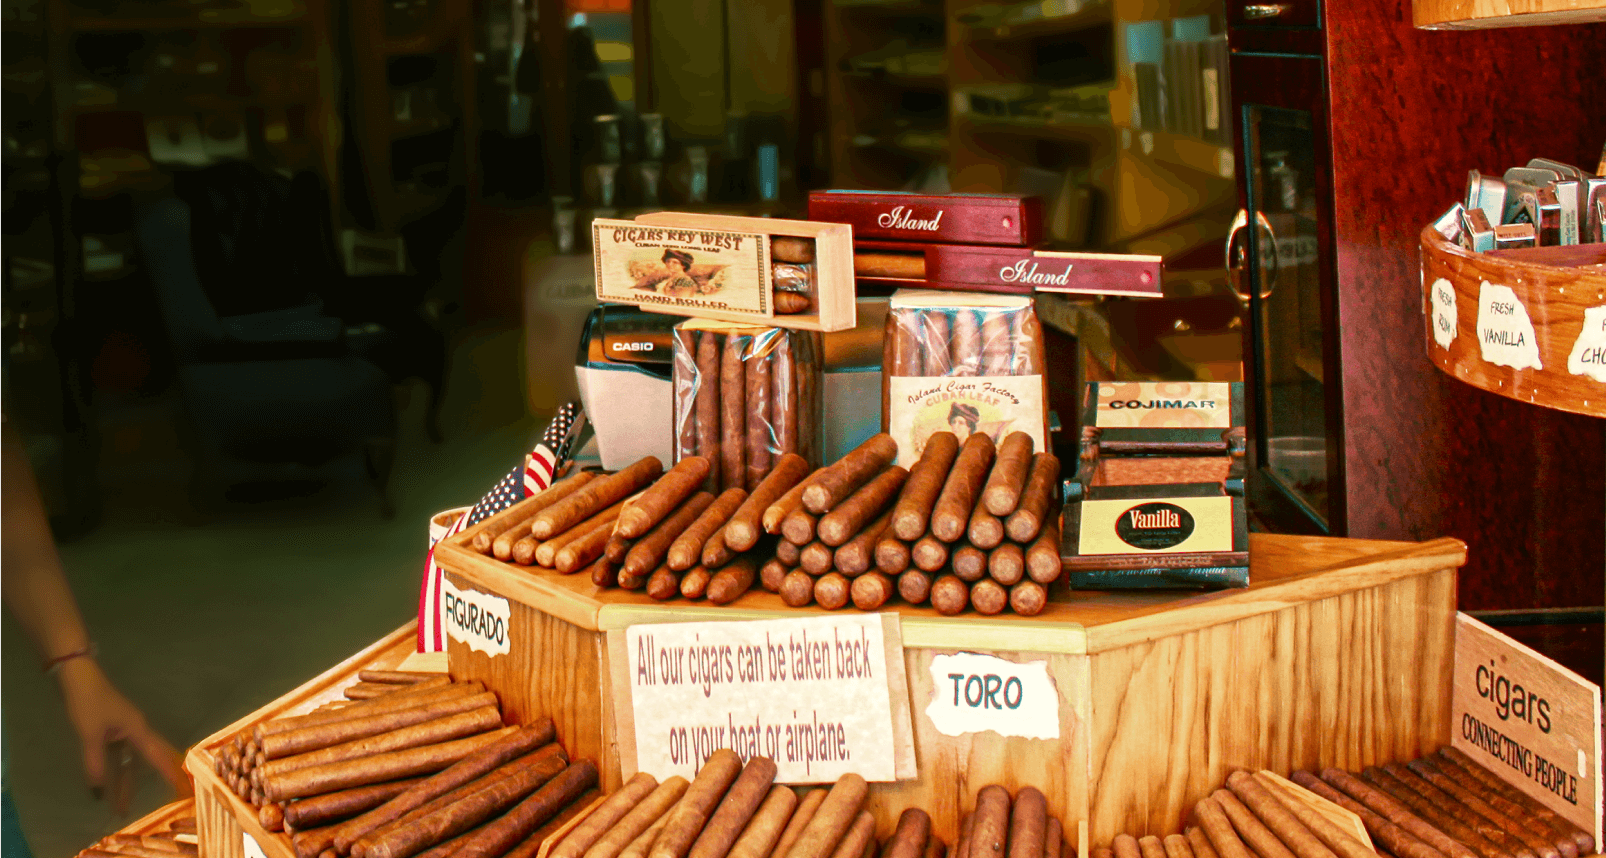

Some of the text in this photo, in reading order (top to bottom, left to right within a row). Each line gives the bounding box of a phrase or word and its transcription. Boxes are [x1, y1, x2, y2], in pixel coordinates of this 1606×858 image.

[877, 206, 943, 231] Island
[613, 229, 743, 250] CIGARS KEY WEST
[999, 259, 1073, 285] Island
[634, 294, 728, 308] HAND ROLLED
[1490, 302, 1514, 316] FRESH
[612, 342, 654, 351] CASIO
[1483, 328, 1525, 347] VANILLA
[908, 380, 1020, 405] Island Cigar Factory
[926, 391, 1000, 407] CUBAN LEAF
[1109, 399, 1215, 409] COJIMAR
[1129, 509, 1181, 529] Vanilla
[445, 591, 504, 646] FIGURADO
[637, 626, 872, 697] All our cigars can be taken back
[947, 673, 1023, 710] TORO
[1476, 659, 1551, 734] cigars
[670, 710, 850, 776] on your boat or airplane.
[1462, 712, 1578, 806] CONNECTING PEOPLE
